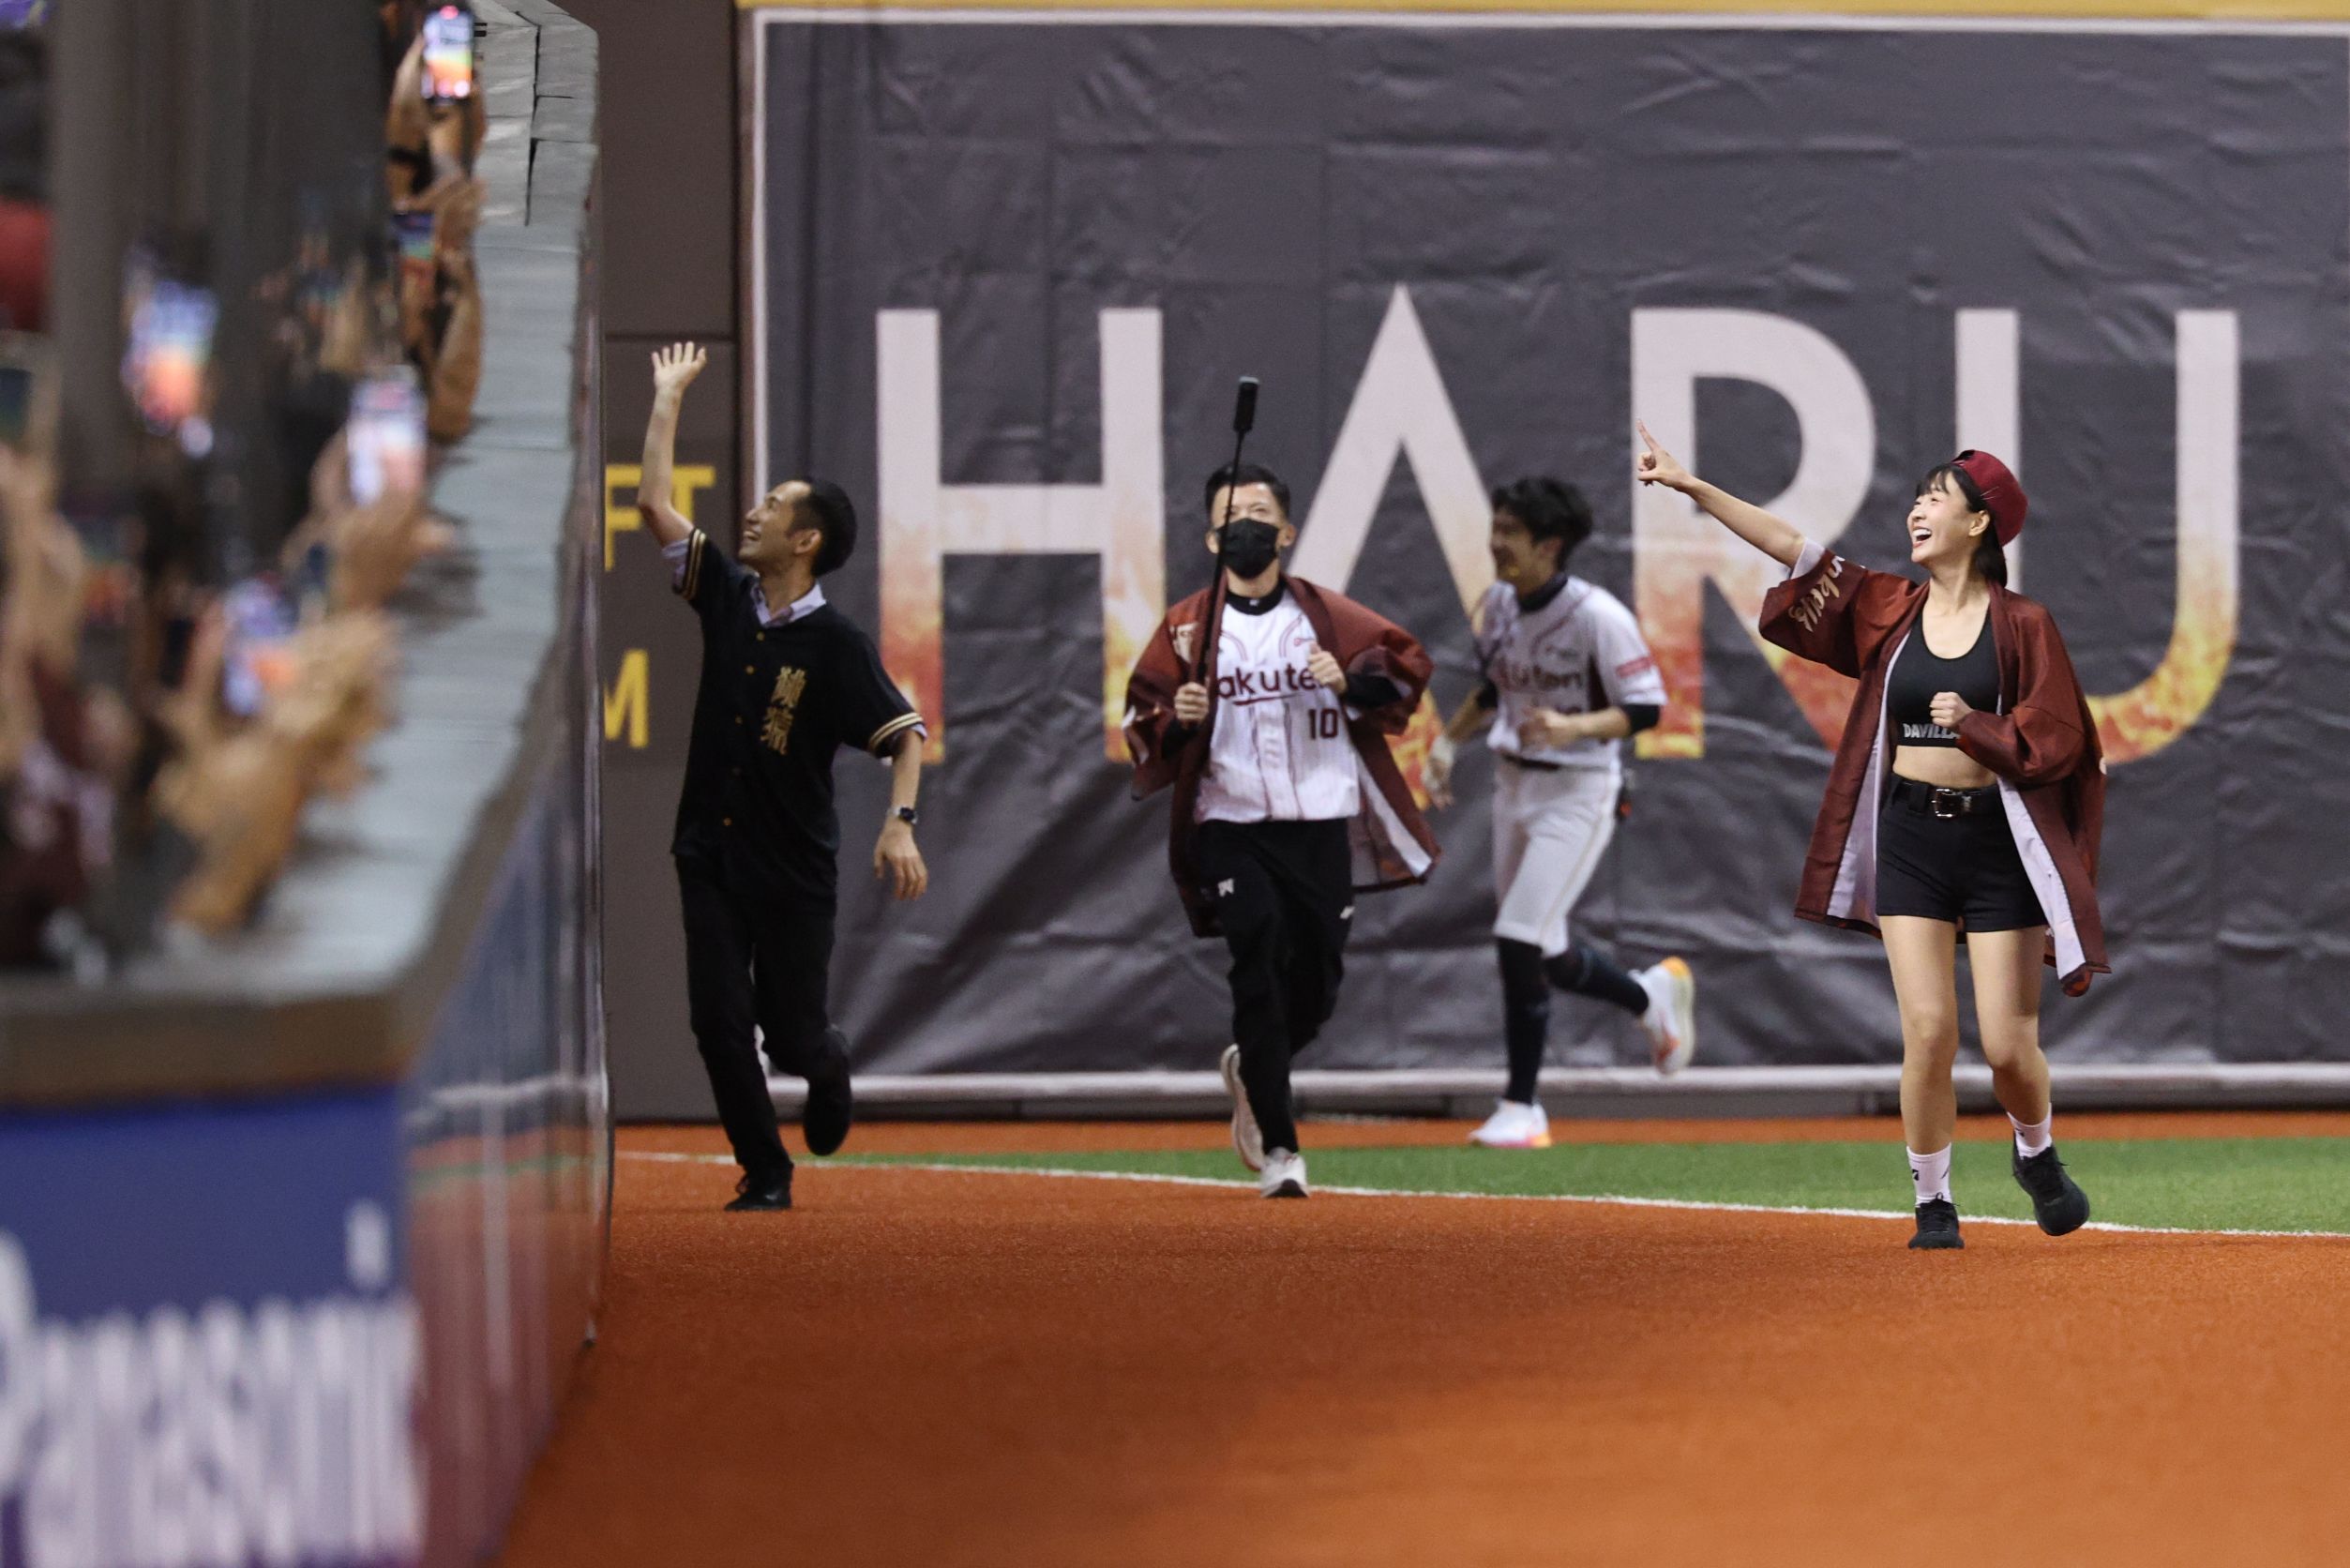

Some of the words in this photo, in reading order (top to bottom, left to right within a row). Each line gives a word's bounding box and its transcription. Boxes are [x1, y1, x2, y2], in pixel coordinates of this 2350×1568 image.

[876, 282, 2241, 765] HARU
[1216, 663, 1325, 700] akute
[1308, 708, 1338, 740] 10
